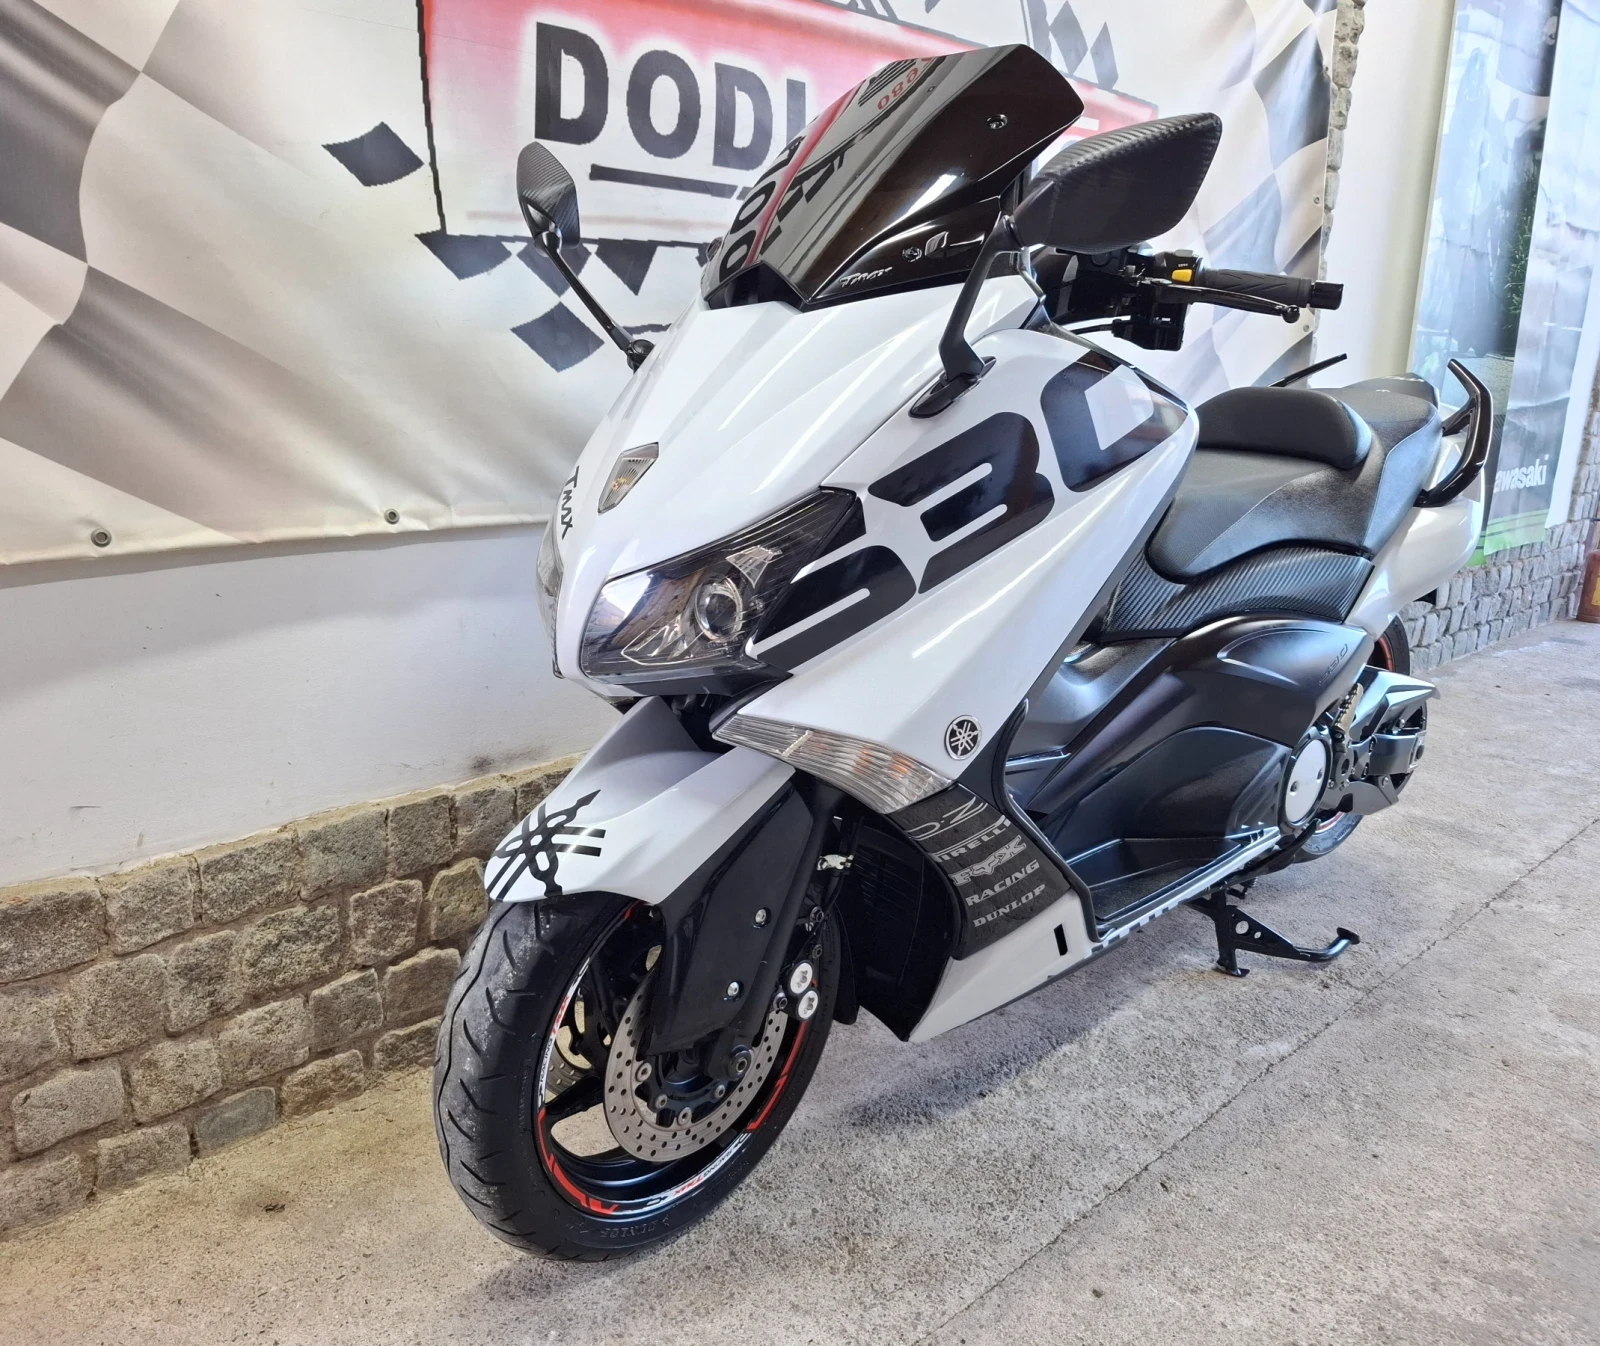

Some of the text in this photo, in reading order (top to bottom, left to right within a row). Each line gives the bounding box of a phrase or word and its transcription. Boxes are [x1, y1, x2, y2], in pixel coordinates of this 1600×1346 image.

[1493, 453, 1549, 494] awasaki
[948, 834, 1027, 886] FOX
[965, 859, 1040, 906] RACING
[973, 884, 1046, 927] DUNLOP
